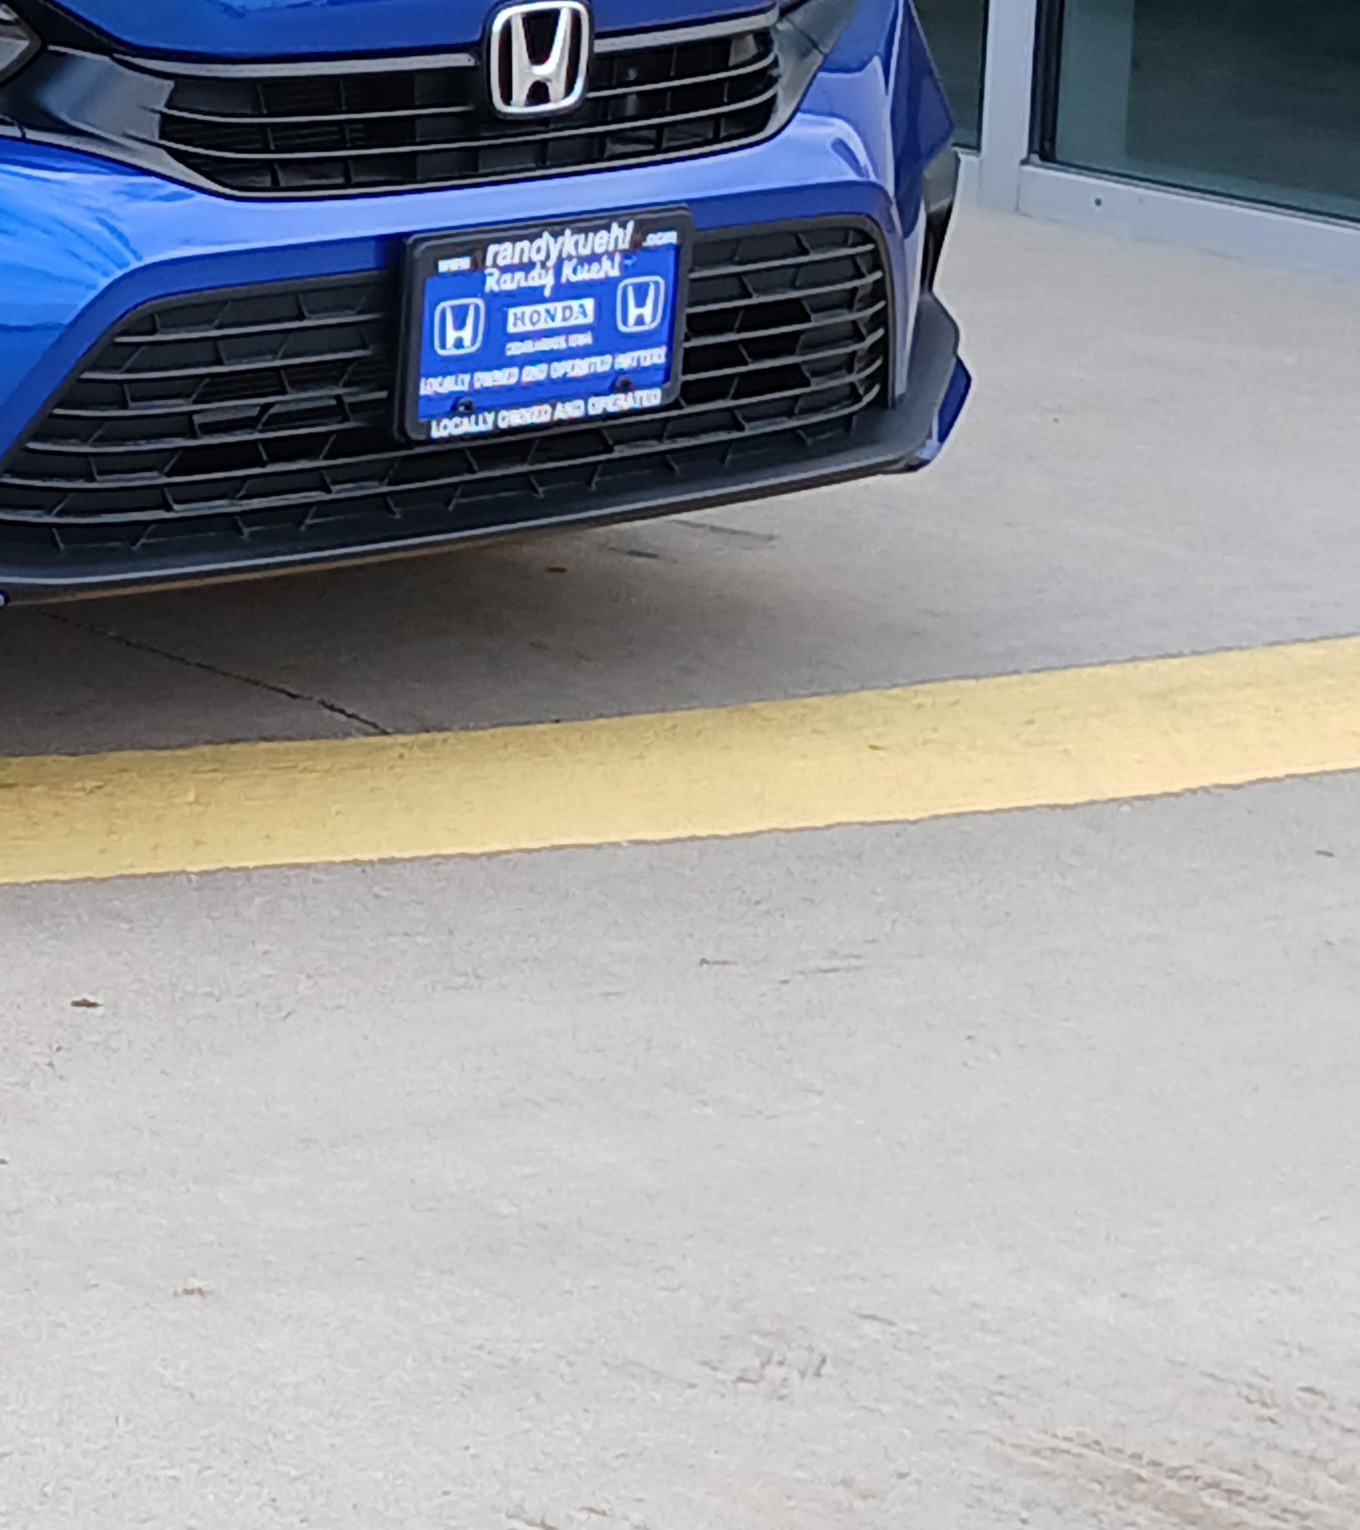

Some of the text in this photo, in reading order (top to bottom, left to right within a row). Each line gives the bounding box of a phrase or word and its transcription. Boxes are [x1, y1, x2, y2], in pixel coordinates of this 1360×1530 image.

[485, 220, 635, 267] randykuehl
[484, 262, 555, 298] Randy
[560, 252, 621, 285] Kuehl
[512, 302, 589, 330] HONDA
[431, 413, 497, 438] LOCALLY
